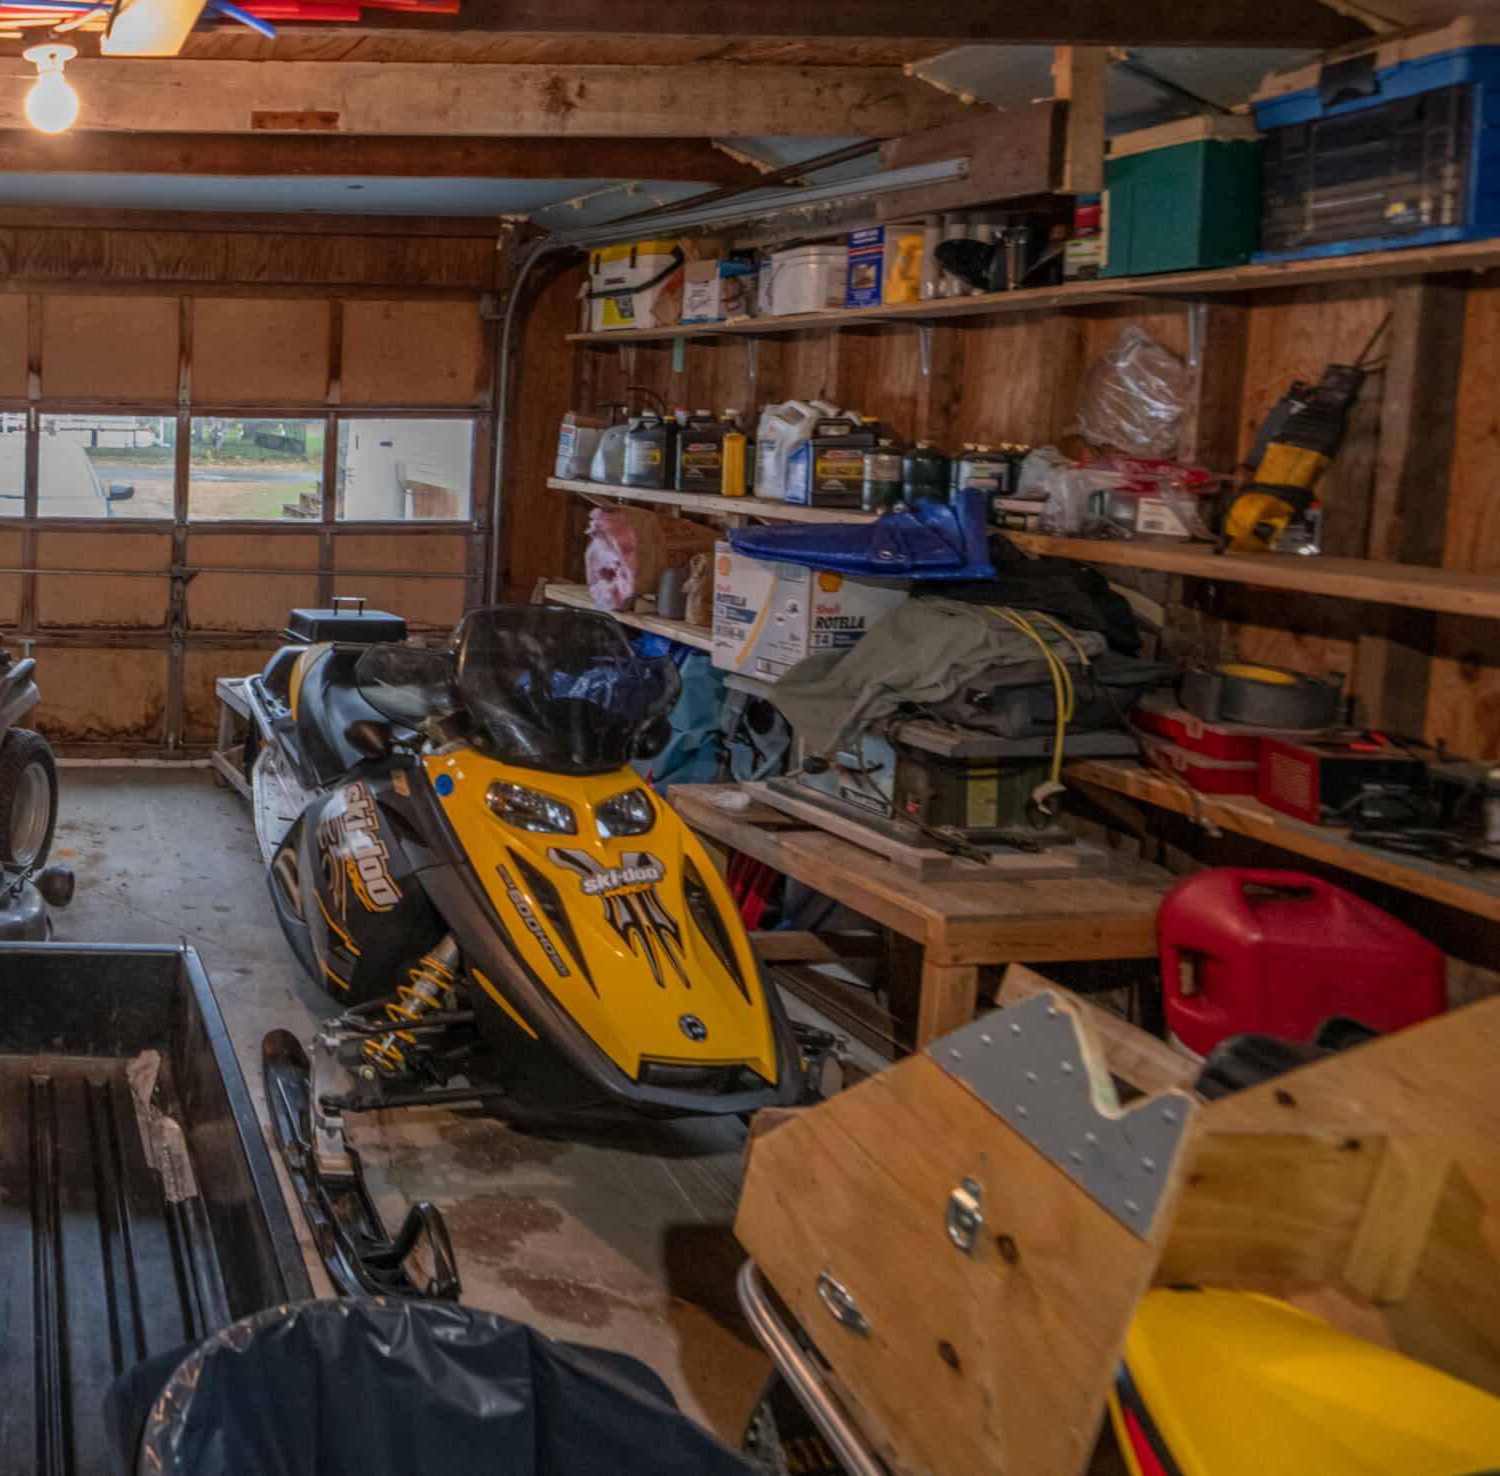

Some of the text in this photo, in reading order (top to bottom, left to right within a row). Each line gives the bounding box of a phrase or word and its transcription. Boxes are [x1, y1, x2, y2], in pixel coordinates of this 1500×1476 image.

[816, 604, 840, 614] Shell
[815, 616, 866, 629] ROTELLA
[814, 634, 830, 645] T4
[583, 867, 659, 893] ski-doo
